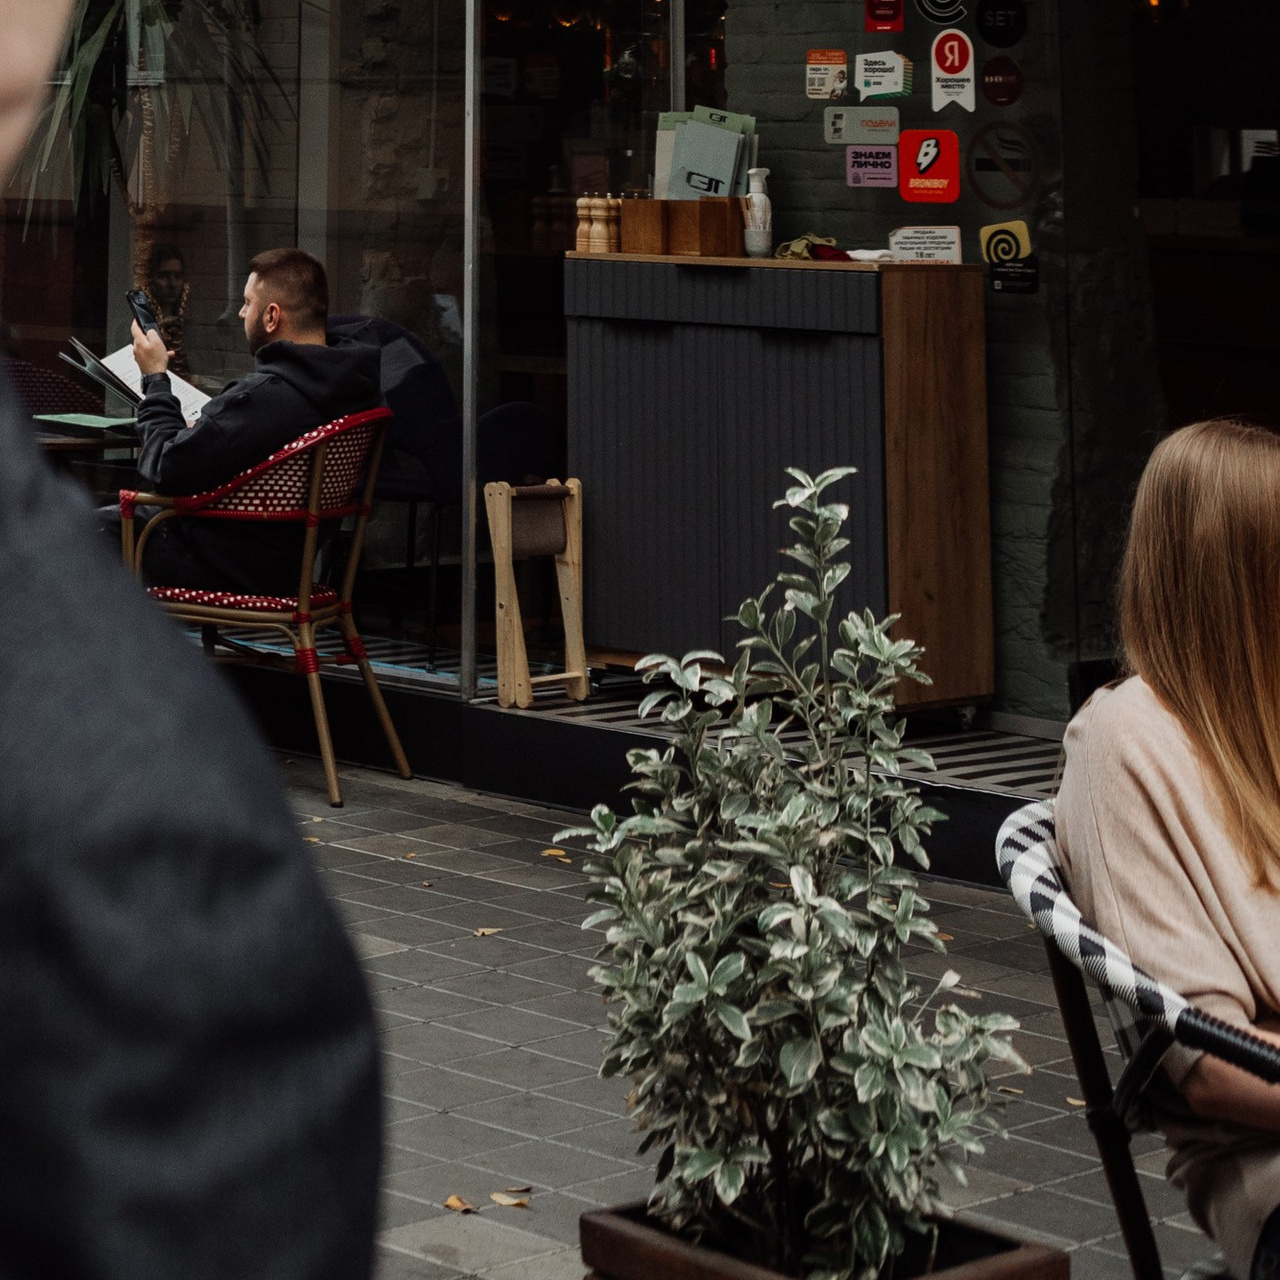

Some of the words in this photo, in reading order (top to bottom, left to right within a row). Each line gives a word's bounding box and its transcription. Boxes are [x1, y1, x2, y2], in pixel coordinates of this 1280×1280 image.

[985, 10, 1017, 27] SET
[944, 41, 960, 67] Я
[863, 59, 887, 67] Здесь
[863, 66, 895, 74] хорошо!
[851, 151, 892, 160] ЗНАЕМ
[851, 160, 892, 169] ЛИЧНО
[909, 178, 950, 189] BRONIBOY
